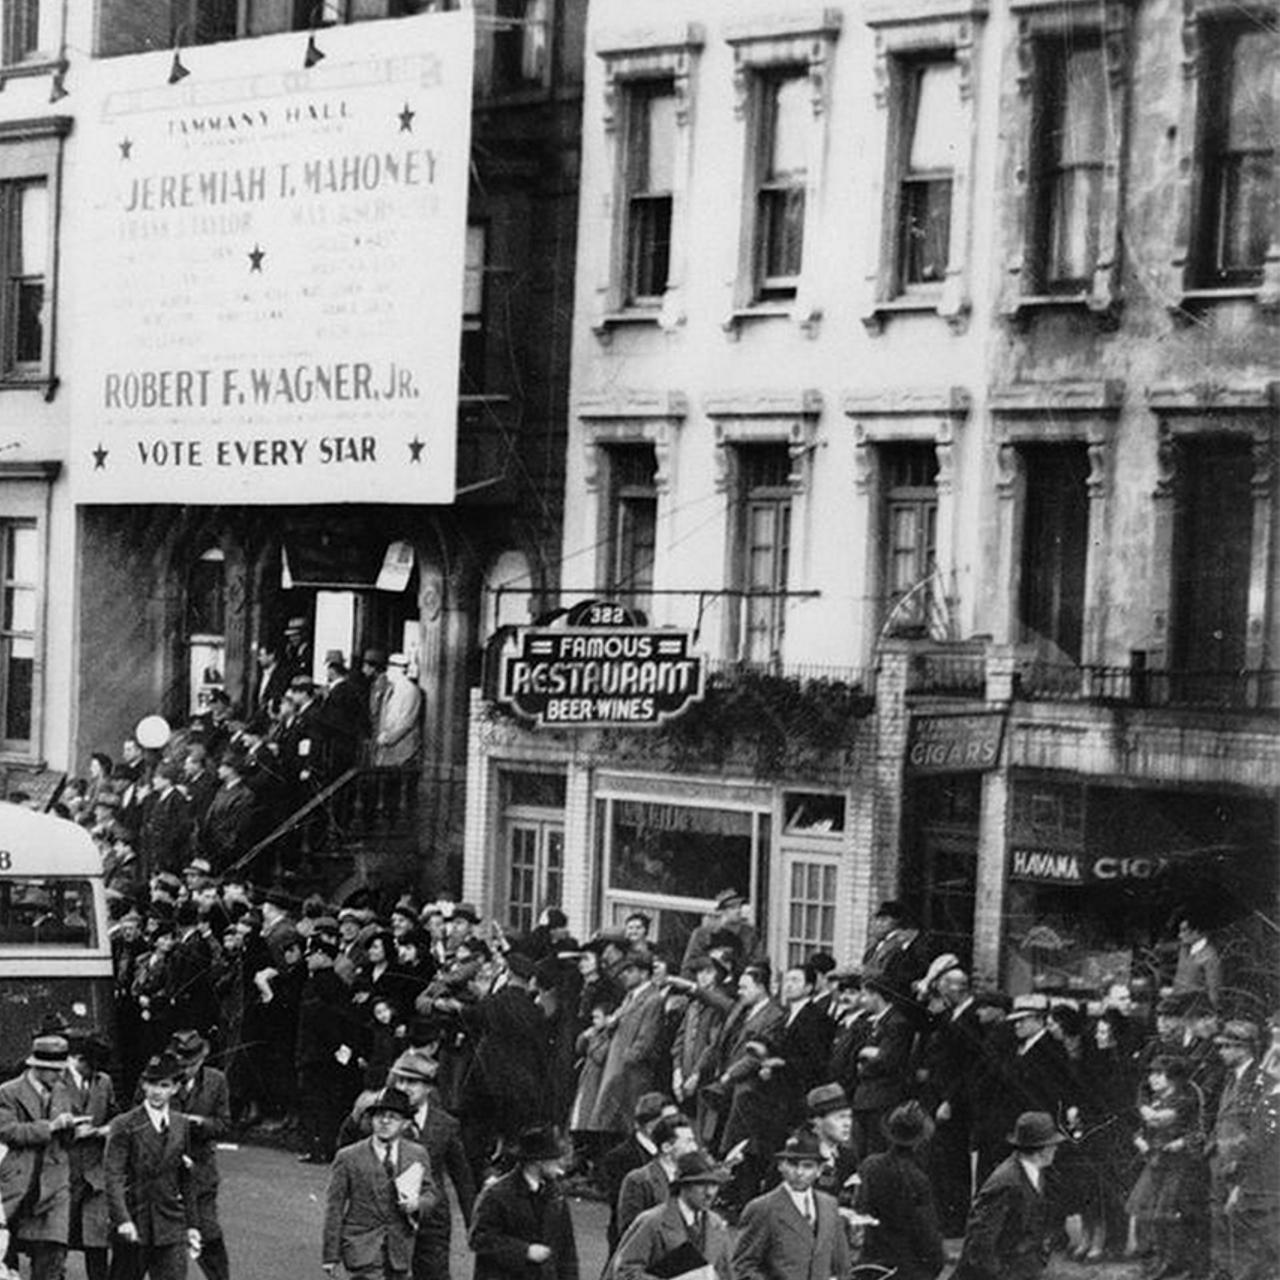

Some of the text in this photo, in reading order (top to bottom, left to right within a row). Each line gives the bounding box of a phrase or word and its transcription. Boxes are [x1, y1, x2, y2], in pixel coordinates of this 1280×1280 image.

[125, 166, 266, 213] JEREMIAH
[304, 149, 437, 195] MAHONEY
[104, 369, 212, 409] ROBERT
[137, 436, 378, 467] VOTE EVERY STAR
[559, 637, 653, 658] FAMOUS
[511, 660, 695, 695] RESTAURANT
[910, 740, 996, 767] CIGARS
[1013, 851, 1080, 879] HAVANA
